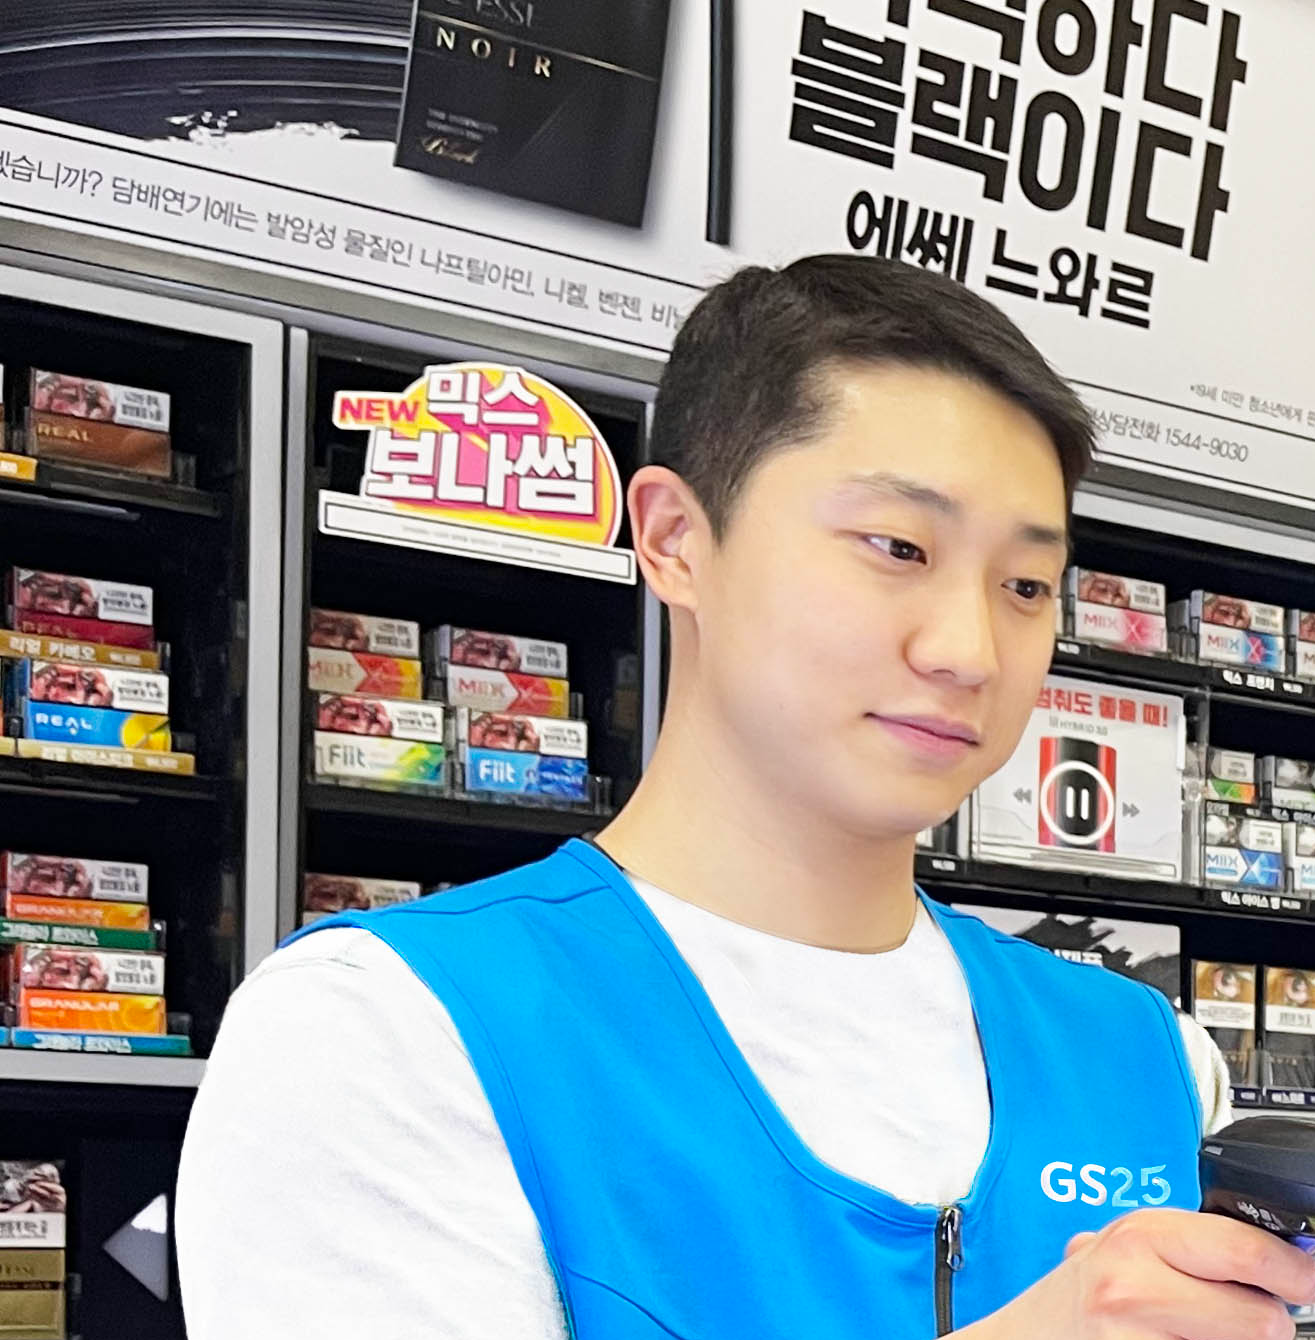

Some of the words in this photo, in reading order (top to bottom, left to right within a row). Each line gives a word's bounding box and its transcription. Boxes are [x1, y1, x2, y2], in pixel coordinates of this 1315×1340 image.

[436, 26, 551, 78] NOIR
[789, 9, 1230, 263] 블랙이다
[112, 176, 258, 232] 담배연기에는
[266, 211, 336, 250] 발암성
[344, 227, 413, 268] 물질인
[985, 226, 1155, 330] 느와르
[339, 397, 421, 423] NEW
[426, 370, 541, 426] 믹스
[365, 427, 596, 516] 보나썸
[1165, 428, 1249, 463] 1544-9030
[1040, 1160, 1172, 1209] GS25
